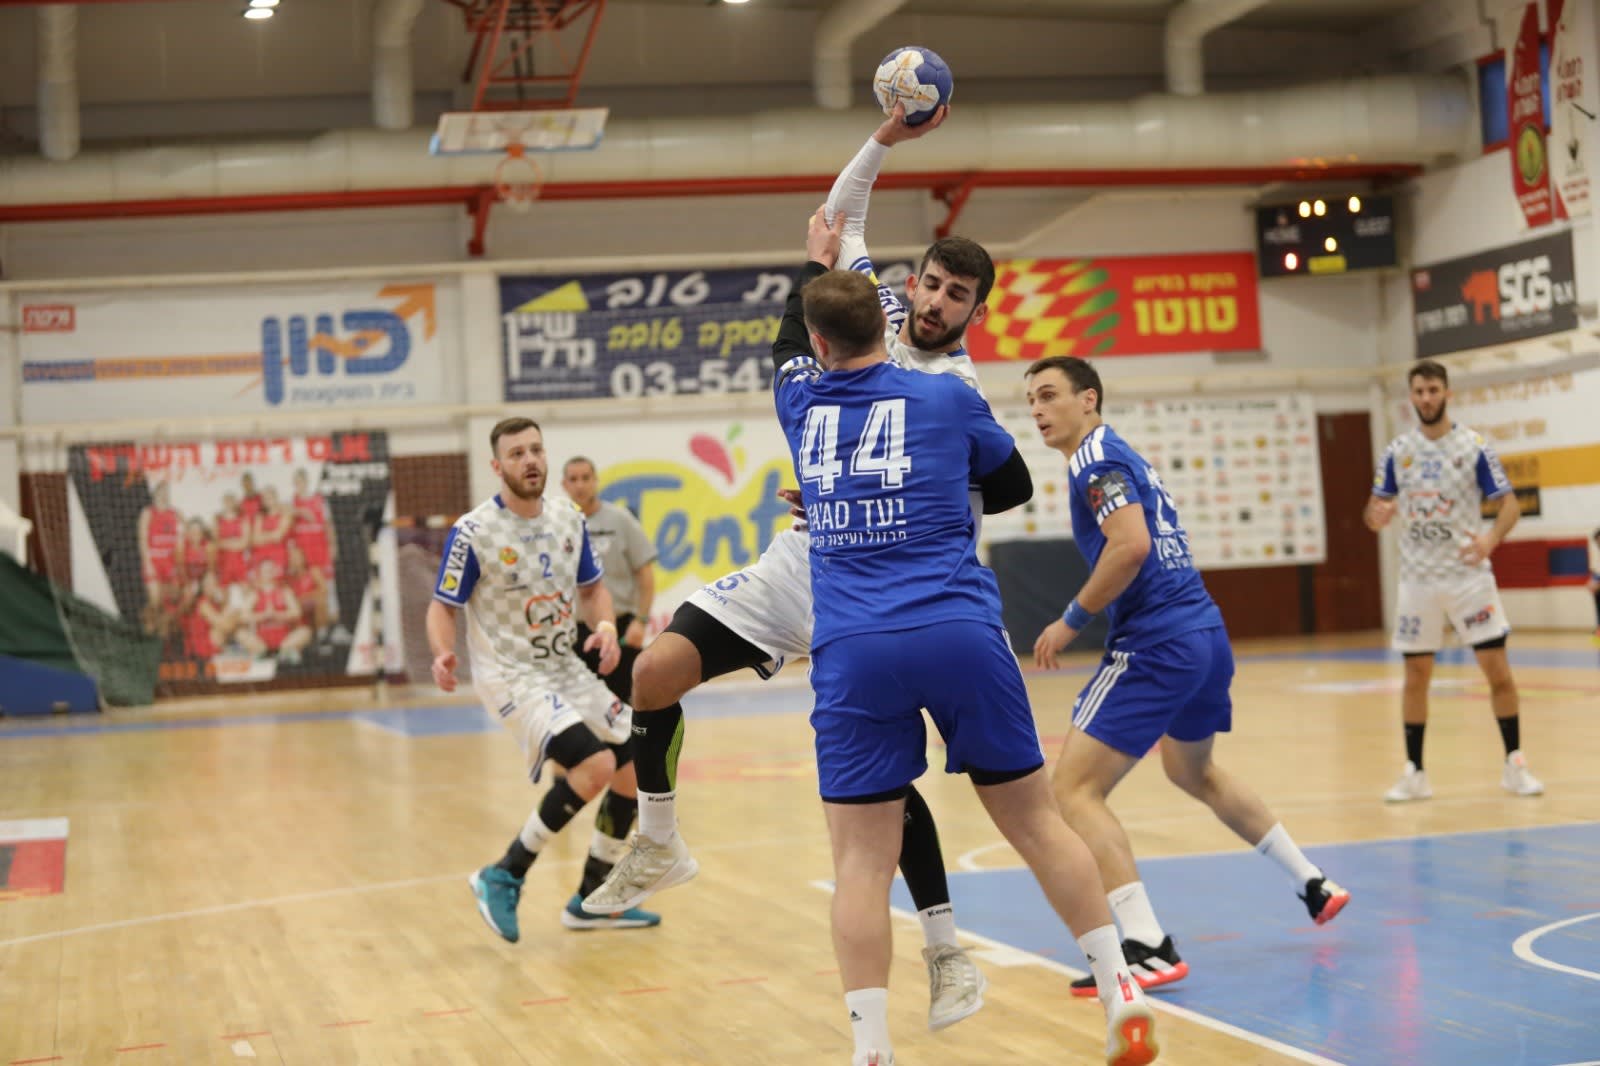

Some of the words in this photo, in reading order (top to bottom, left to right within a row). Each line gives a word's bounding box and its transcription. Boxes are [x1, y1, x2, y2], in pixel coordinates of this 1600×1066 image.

[1499, 255, 1552, 317] SGS
[1133, 296, 1238, 336] טוטו
[799, 399, 912, 496] 44
[445, 518, 481, 573] VARTA
[1409, 520, 1453, 541] SGS
[538, 553, 553, 579] 2
[715, 572, 750, 592] 5
